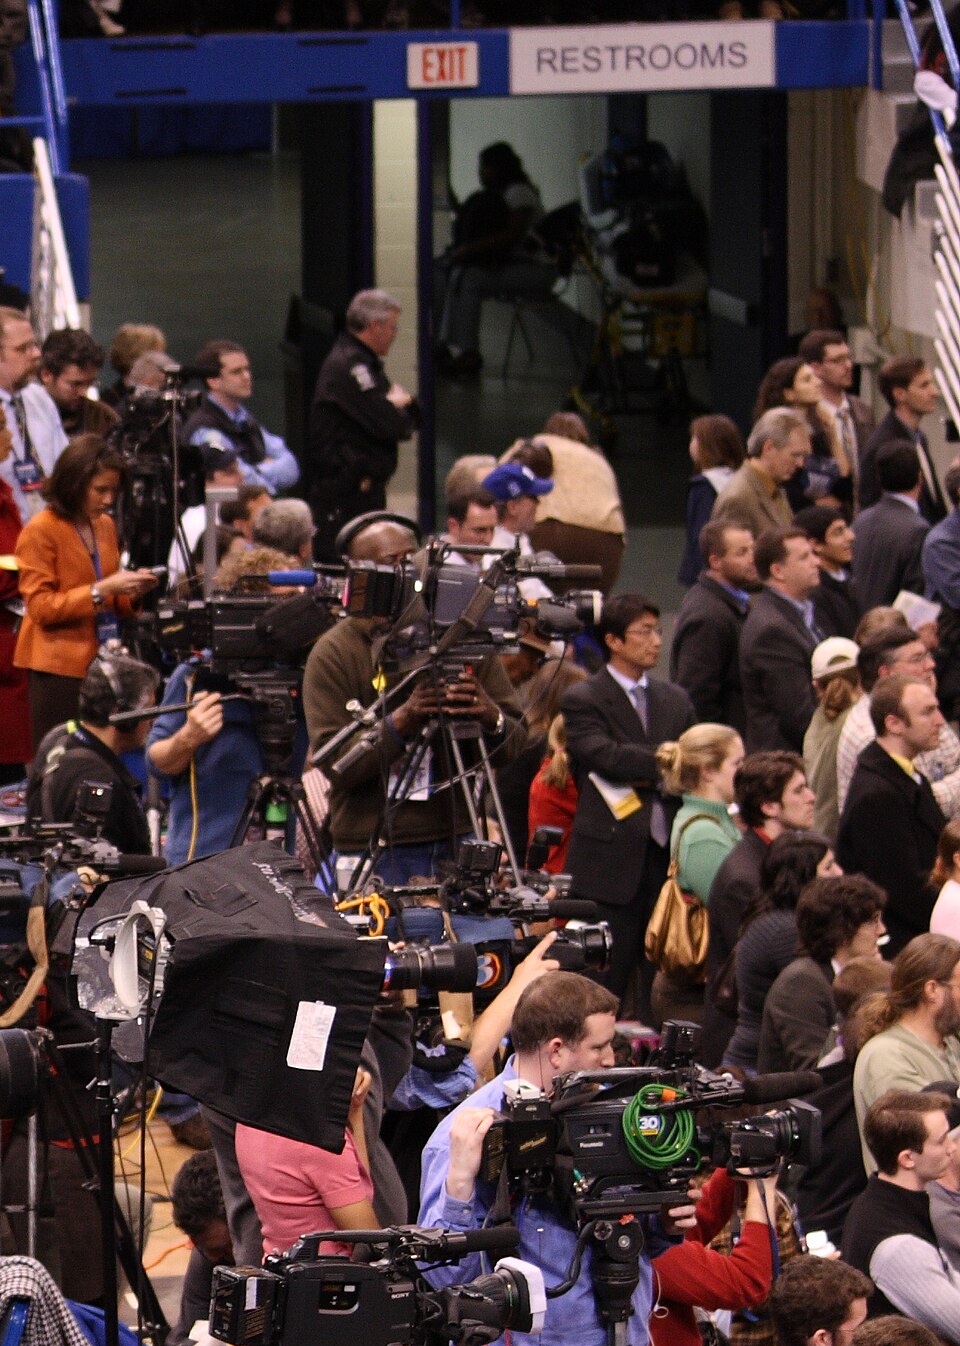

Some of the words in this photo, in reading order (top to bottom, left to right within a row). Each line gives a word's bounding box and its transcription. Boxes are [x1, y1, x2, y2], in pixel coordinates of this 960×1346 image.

[422, 47, 467, 82] EXIT
[537, 42, 747, 74] RESTROOMS
[639, 1117, 658, 1129] 30
